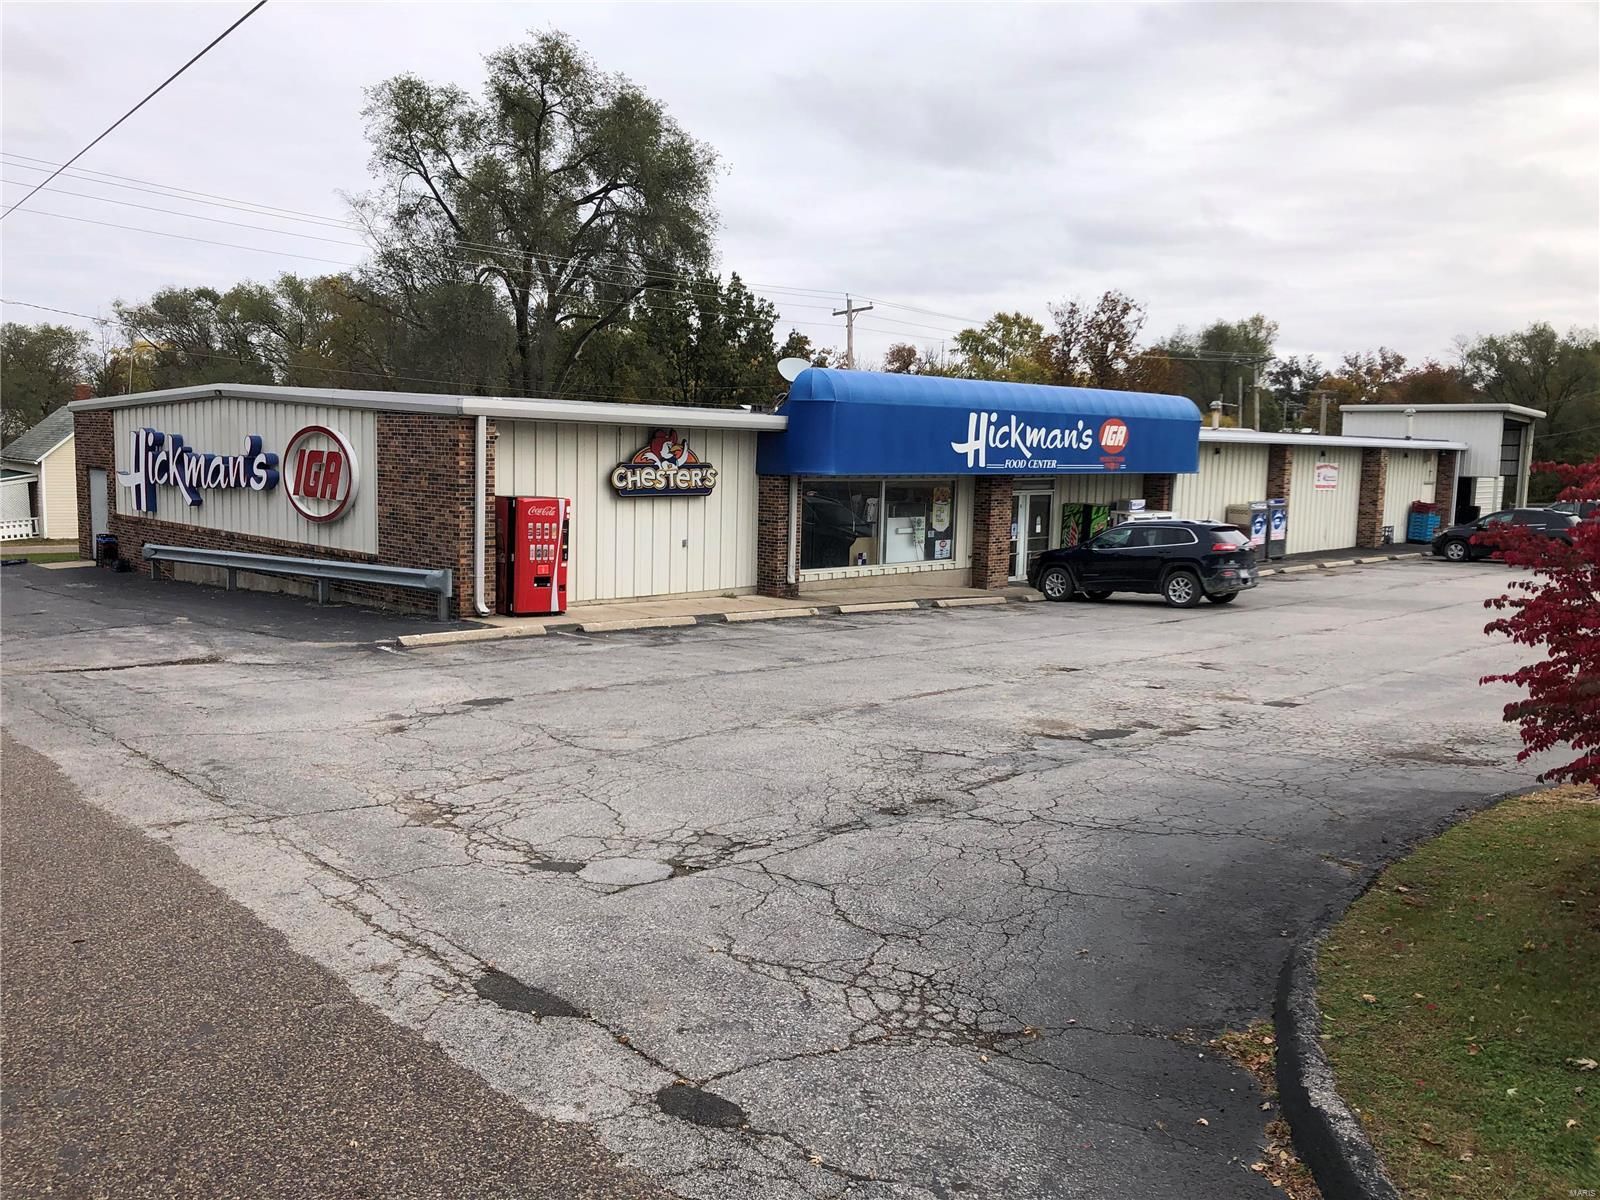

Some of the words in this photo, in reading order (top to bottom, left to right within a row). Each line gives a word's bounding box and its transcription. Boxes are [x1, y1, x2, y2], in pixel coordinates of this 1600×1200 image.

[951, 412, 1093, 468] Hickman's
[1101, 425, 1127, 446] IGA
[117, 427, 274, 512] Hickman's
[293, 449, 343, 500] IGA
[1004, 459, 1026, 469] FOOD
[1028, 459, 1057, 469] CENTER
